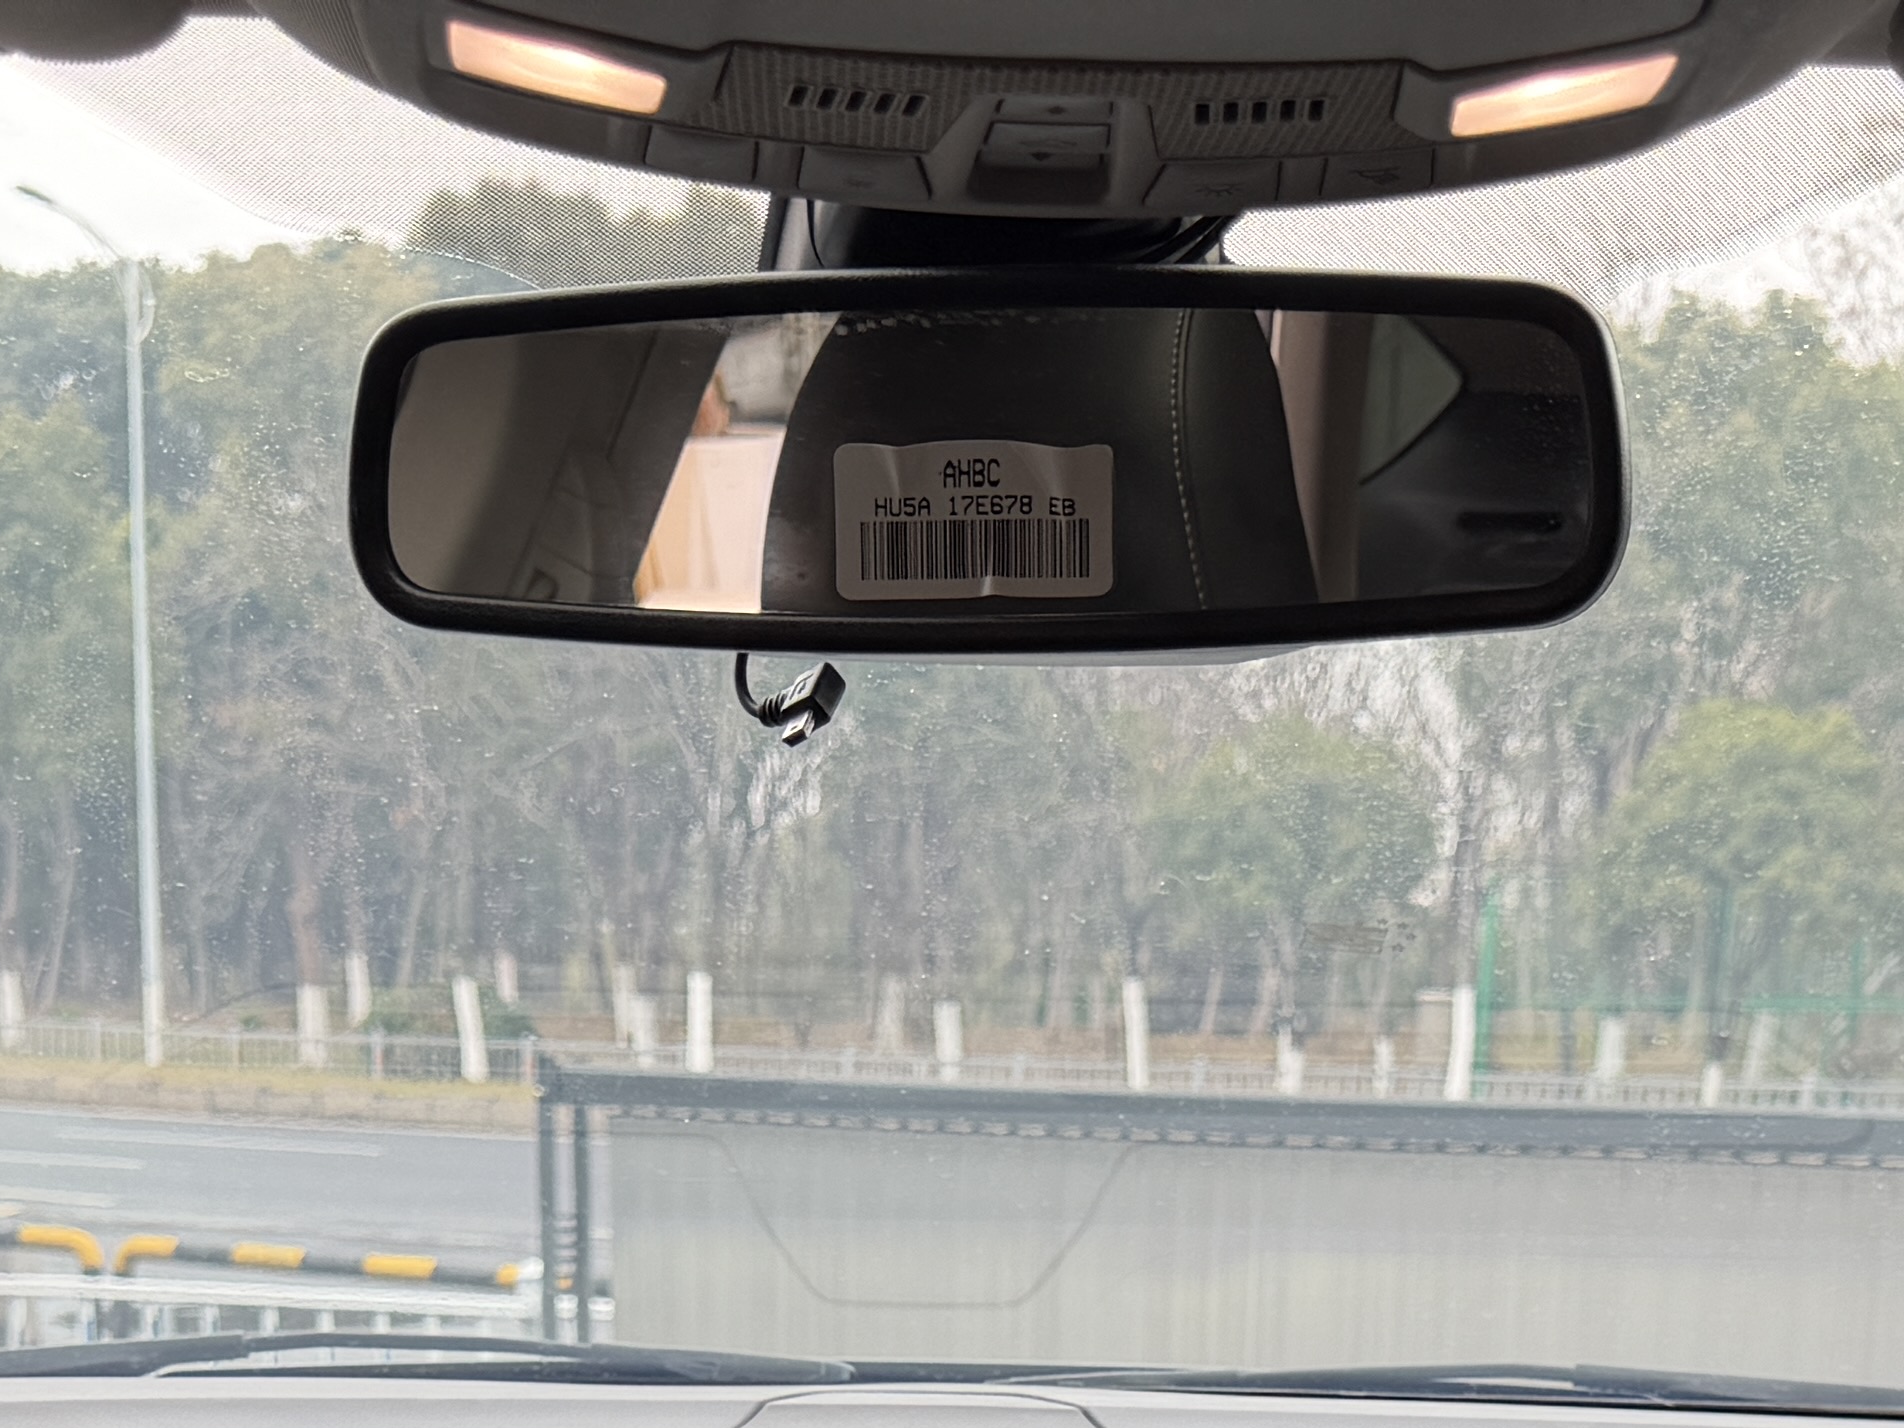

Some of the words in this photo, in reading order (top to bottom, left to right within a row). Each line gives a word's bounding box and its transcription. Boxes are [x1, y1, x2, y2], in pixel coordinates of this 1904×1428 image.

[942, 458, 1001, 489] AHBC
[874, 497, 932, 518] HU5A
[948, 495, 1034, 517] 17E678
[1048, 496, 1077, 517] EB
